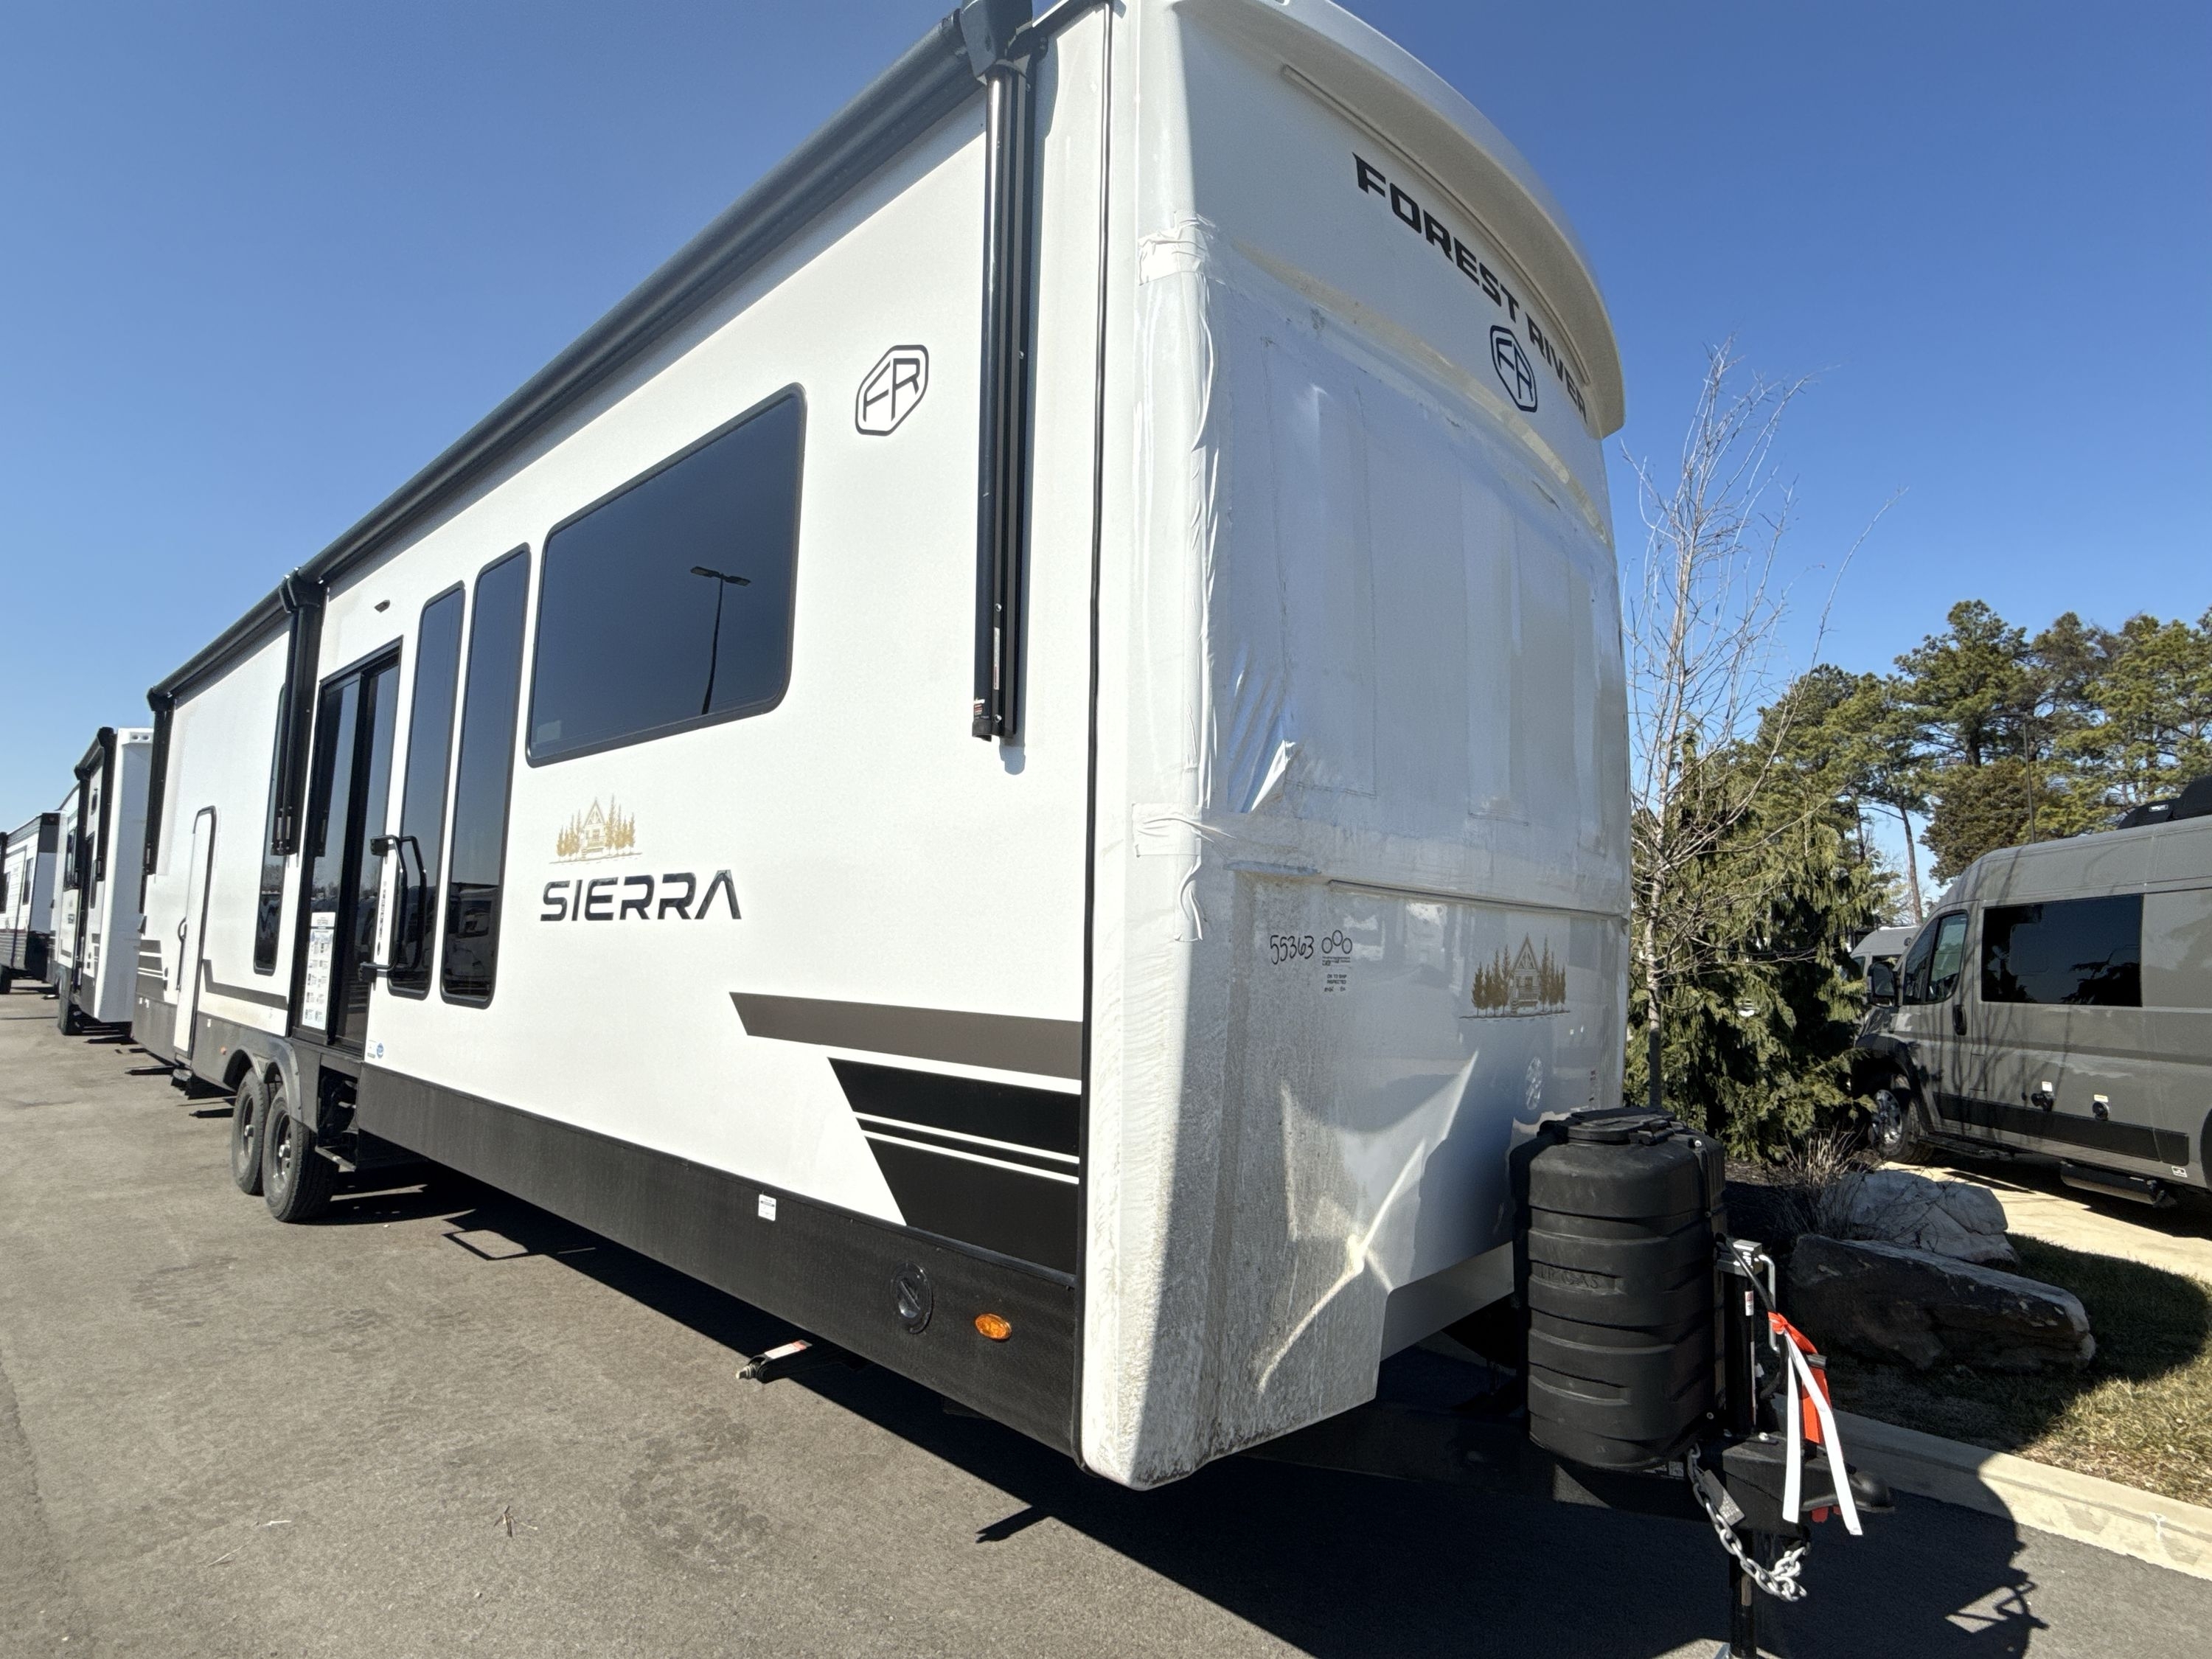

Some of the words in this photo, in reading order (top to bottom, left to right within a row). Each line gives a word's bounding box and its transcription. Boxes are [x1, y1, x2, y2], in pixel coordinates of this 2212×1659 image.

[1352, 152, 1520, 323] FOREST
[1525, 311, 1588, 425] RIVER
[862, 357, 921, 423] FR
[1495, 335, 1534, 403] FR
[540, 869, 742, 922] SIERRA
[1270, 935, 1315, 965] 55363
[1561, 1270, 1599, 1289] GAS
